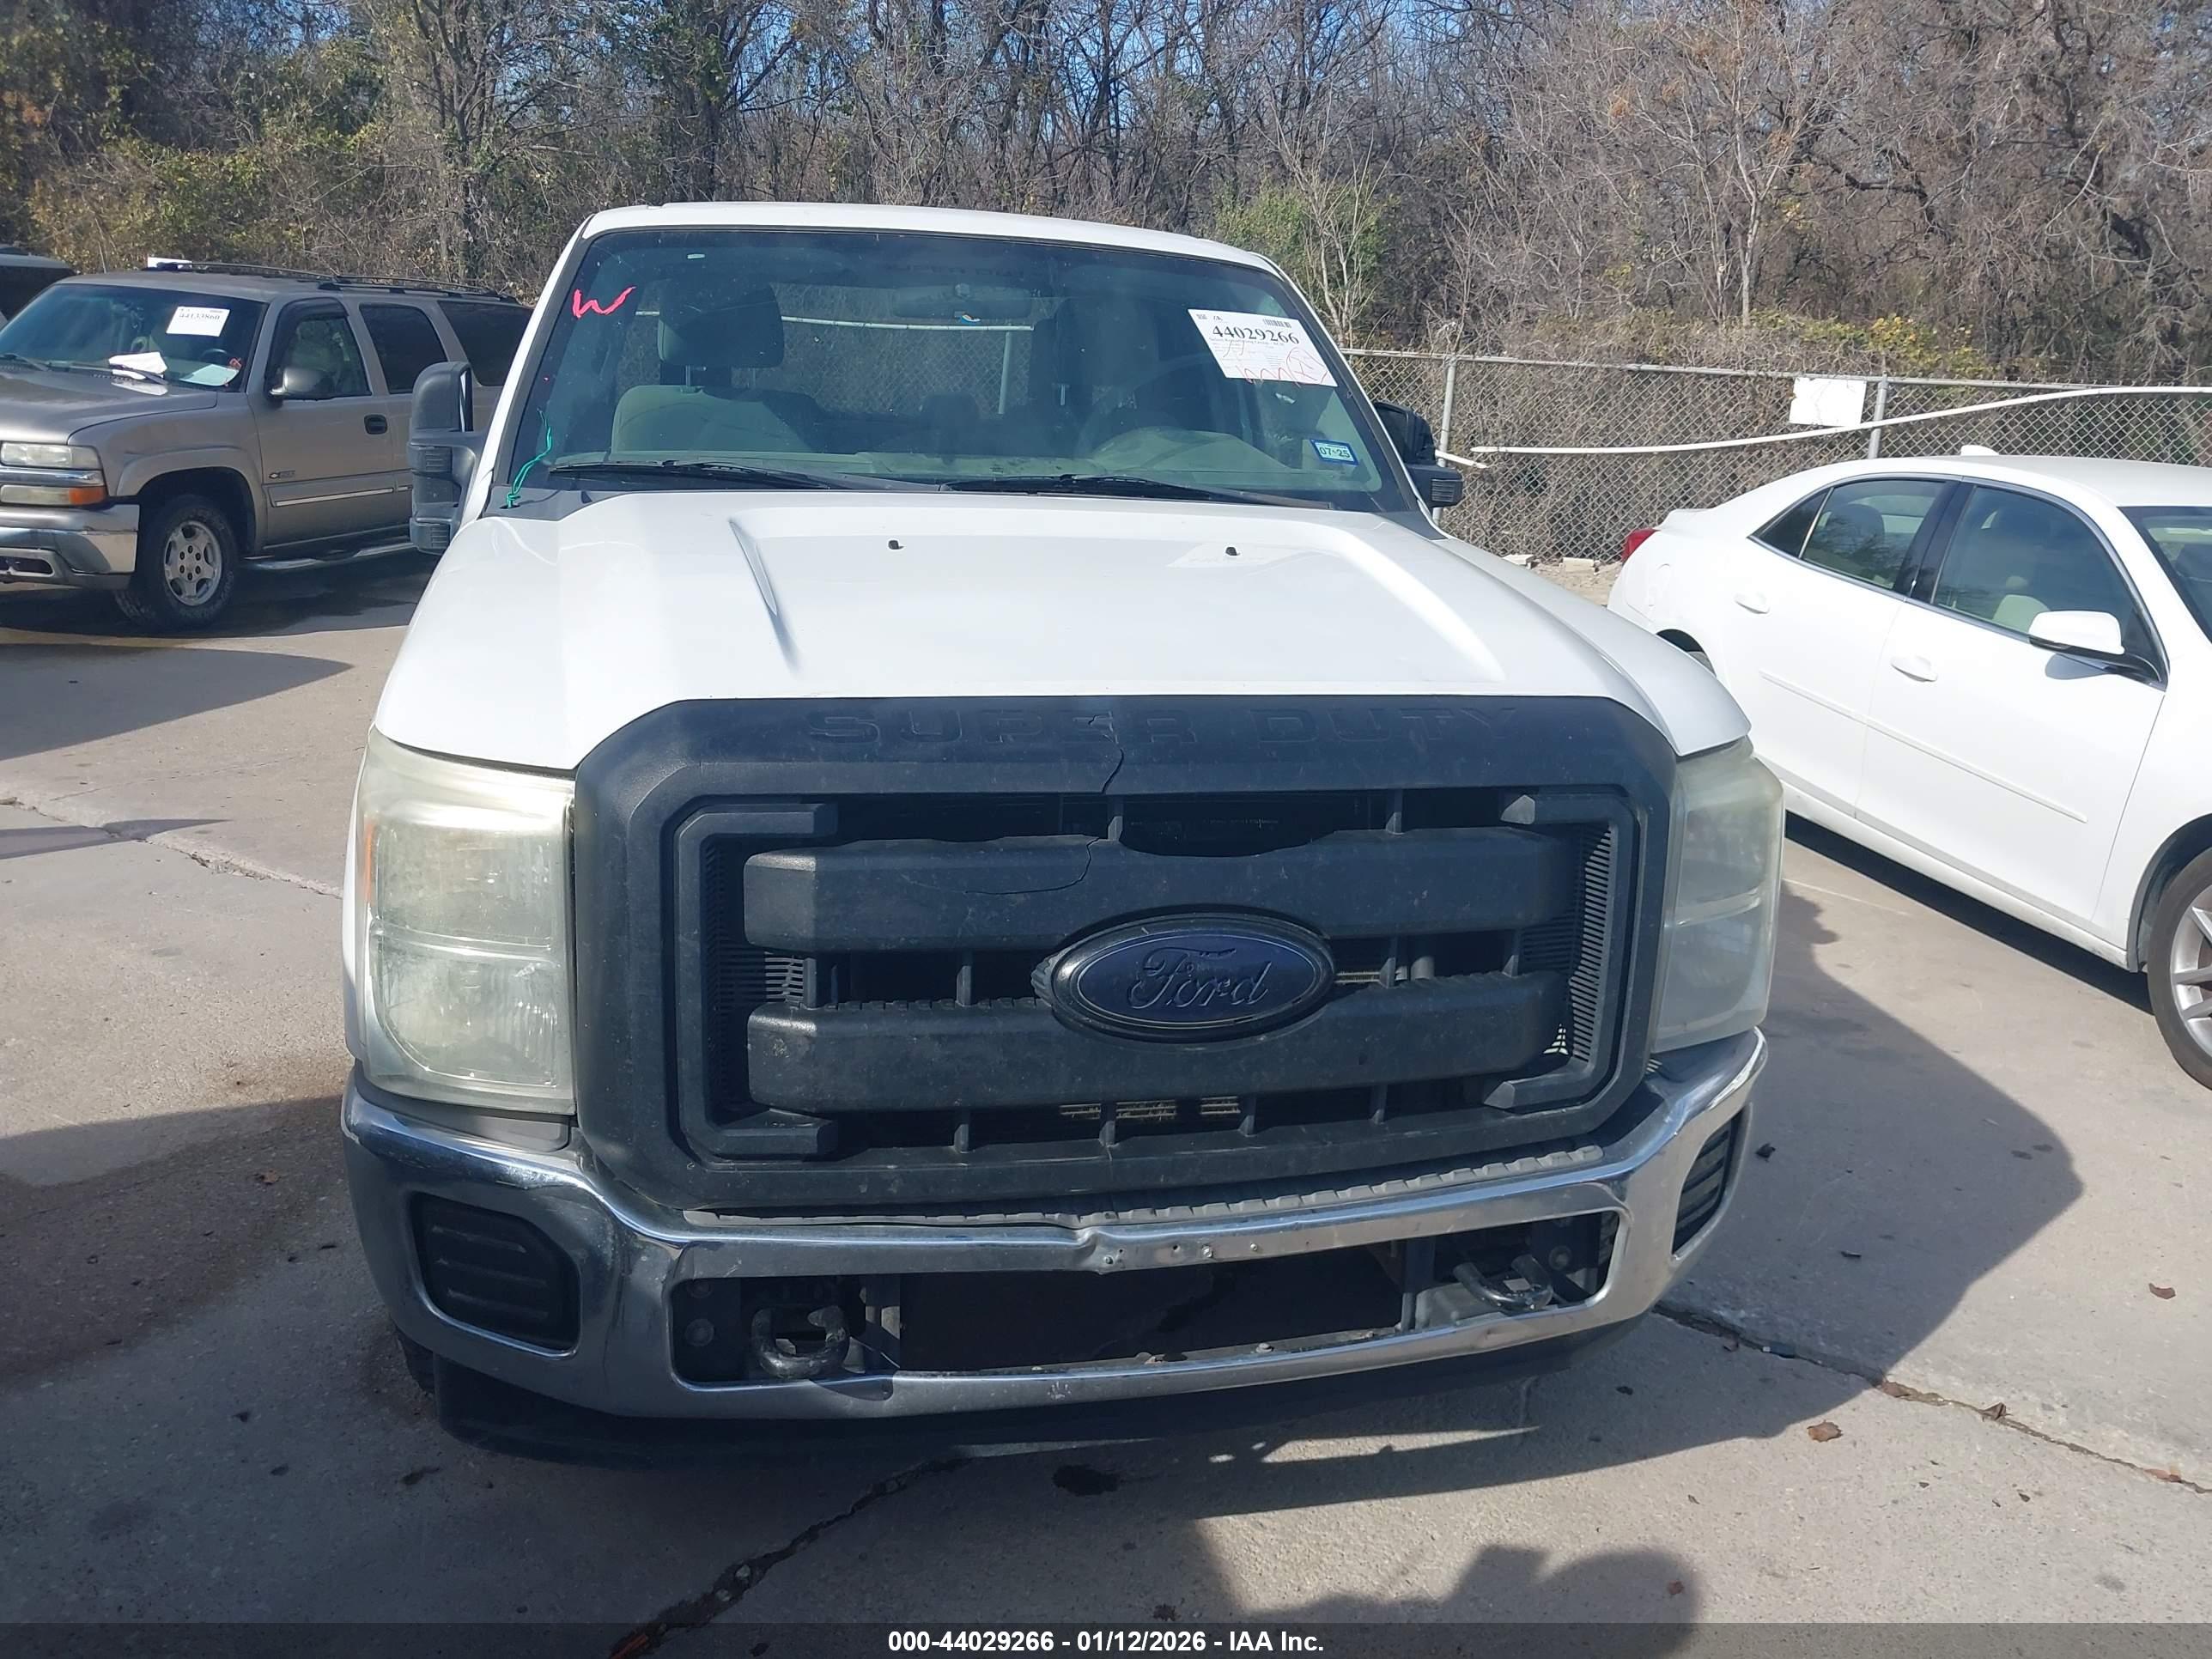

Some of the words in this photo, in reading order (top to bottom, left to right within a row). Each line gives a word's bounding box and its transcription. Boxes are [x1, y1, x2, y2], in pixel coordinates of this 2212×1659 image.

[1212, 325, 1300, 345] 44029266
[807, 708, 1199, 744] SUPER
[1249, 707, 1518, 744] DUTY
[1126, 945, 1273, 1010] Ford
